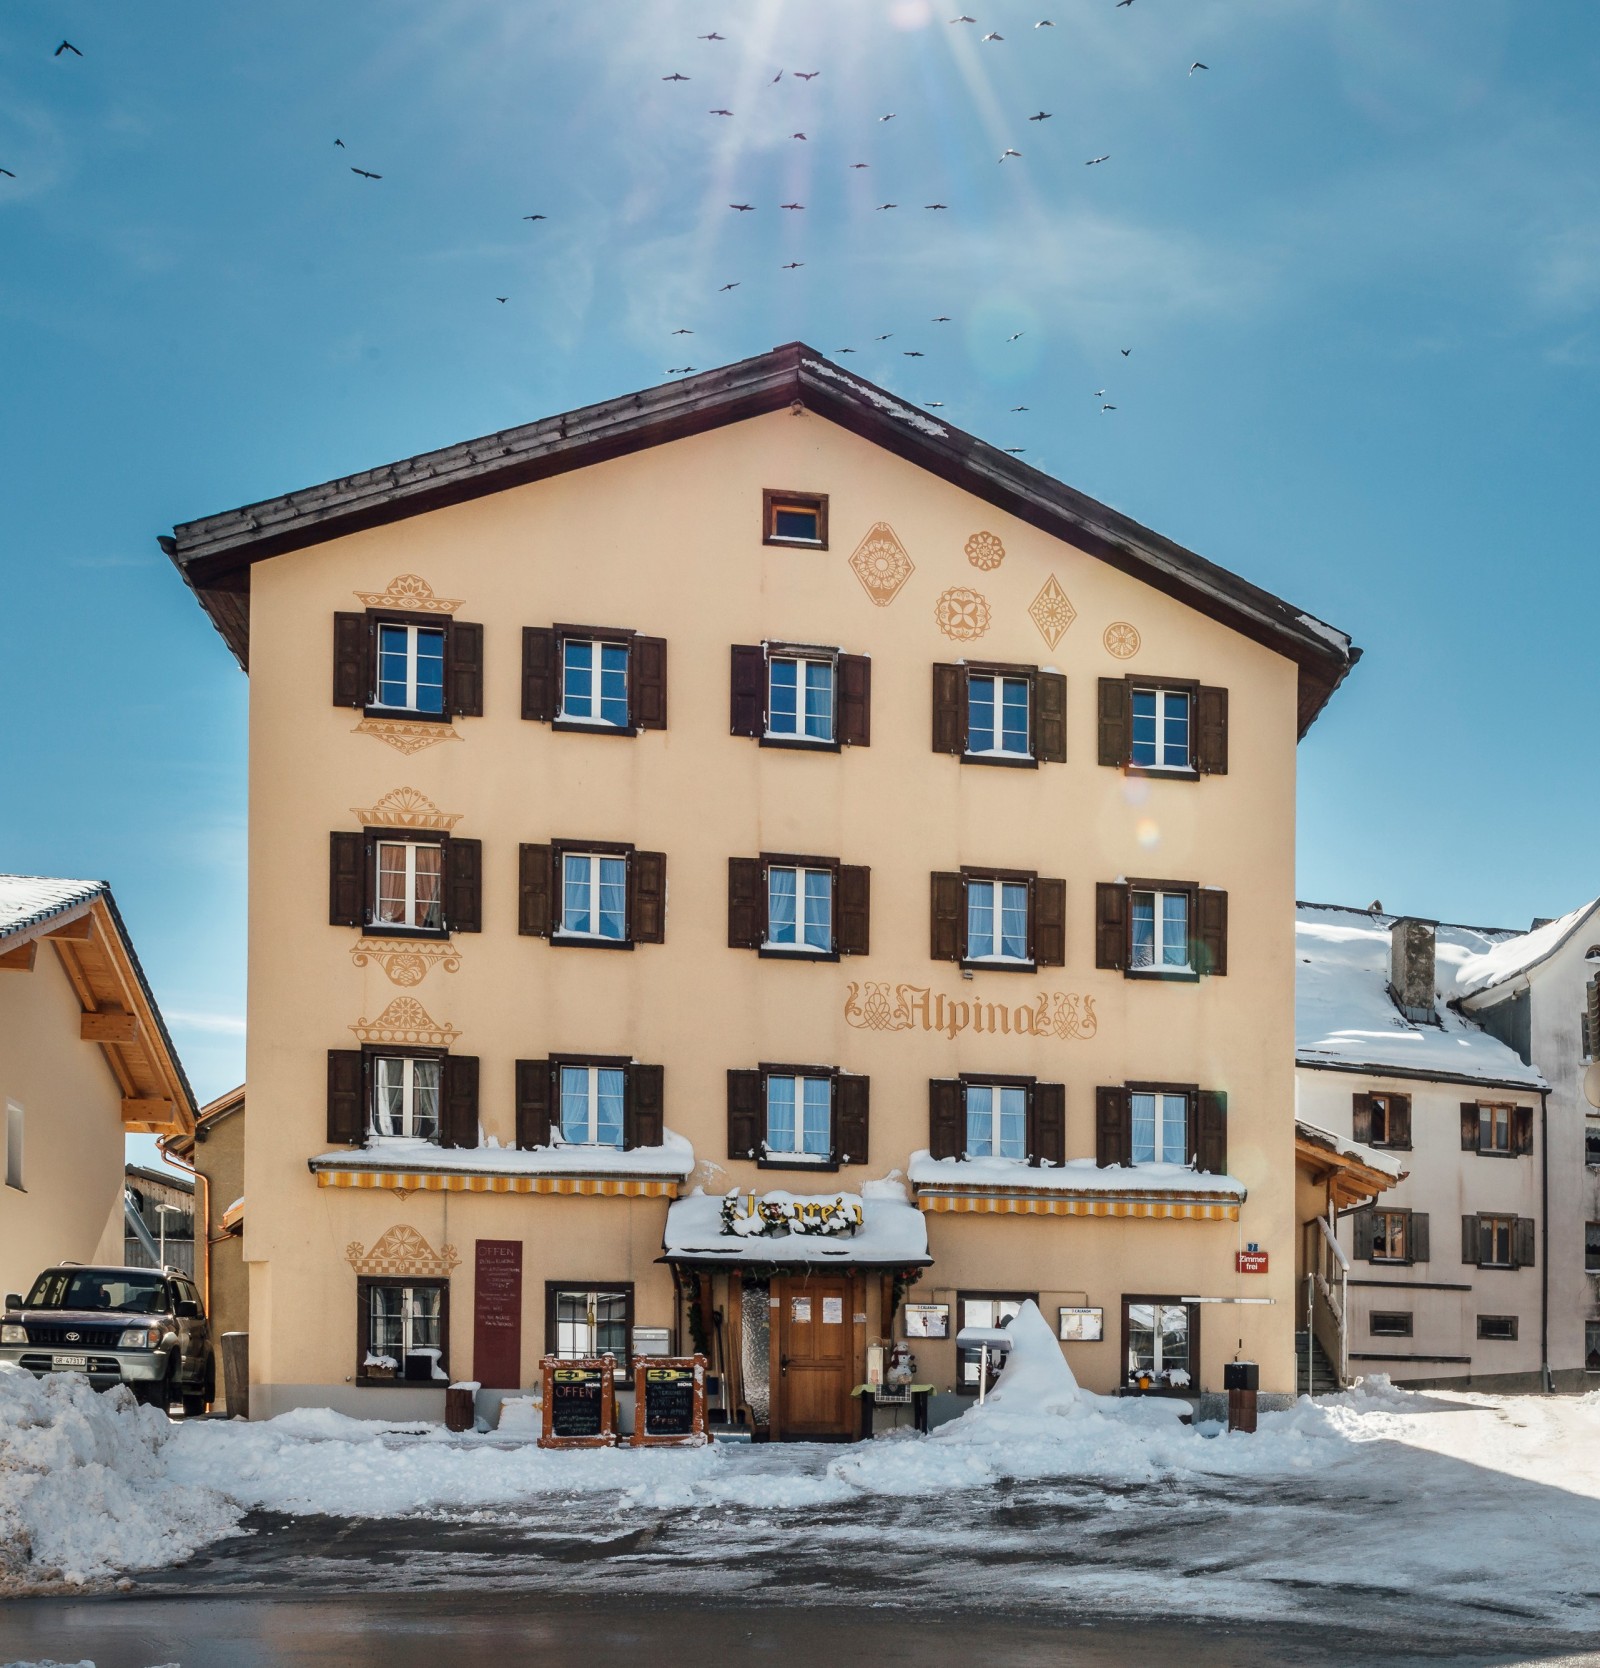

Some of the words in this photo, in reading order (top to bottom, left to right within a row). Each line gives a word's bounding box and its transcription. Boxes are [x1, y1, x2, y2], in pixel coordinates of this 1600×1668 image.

[897, 984, 1040, 1040] Alpina
[478, 1246, 514, 1257] OFFEN
[1239, 1255, 1267, 1263] Zimmer
[555, 1385, 594, 1399] OFFEN
